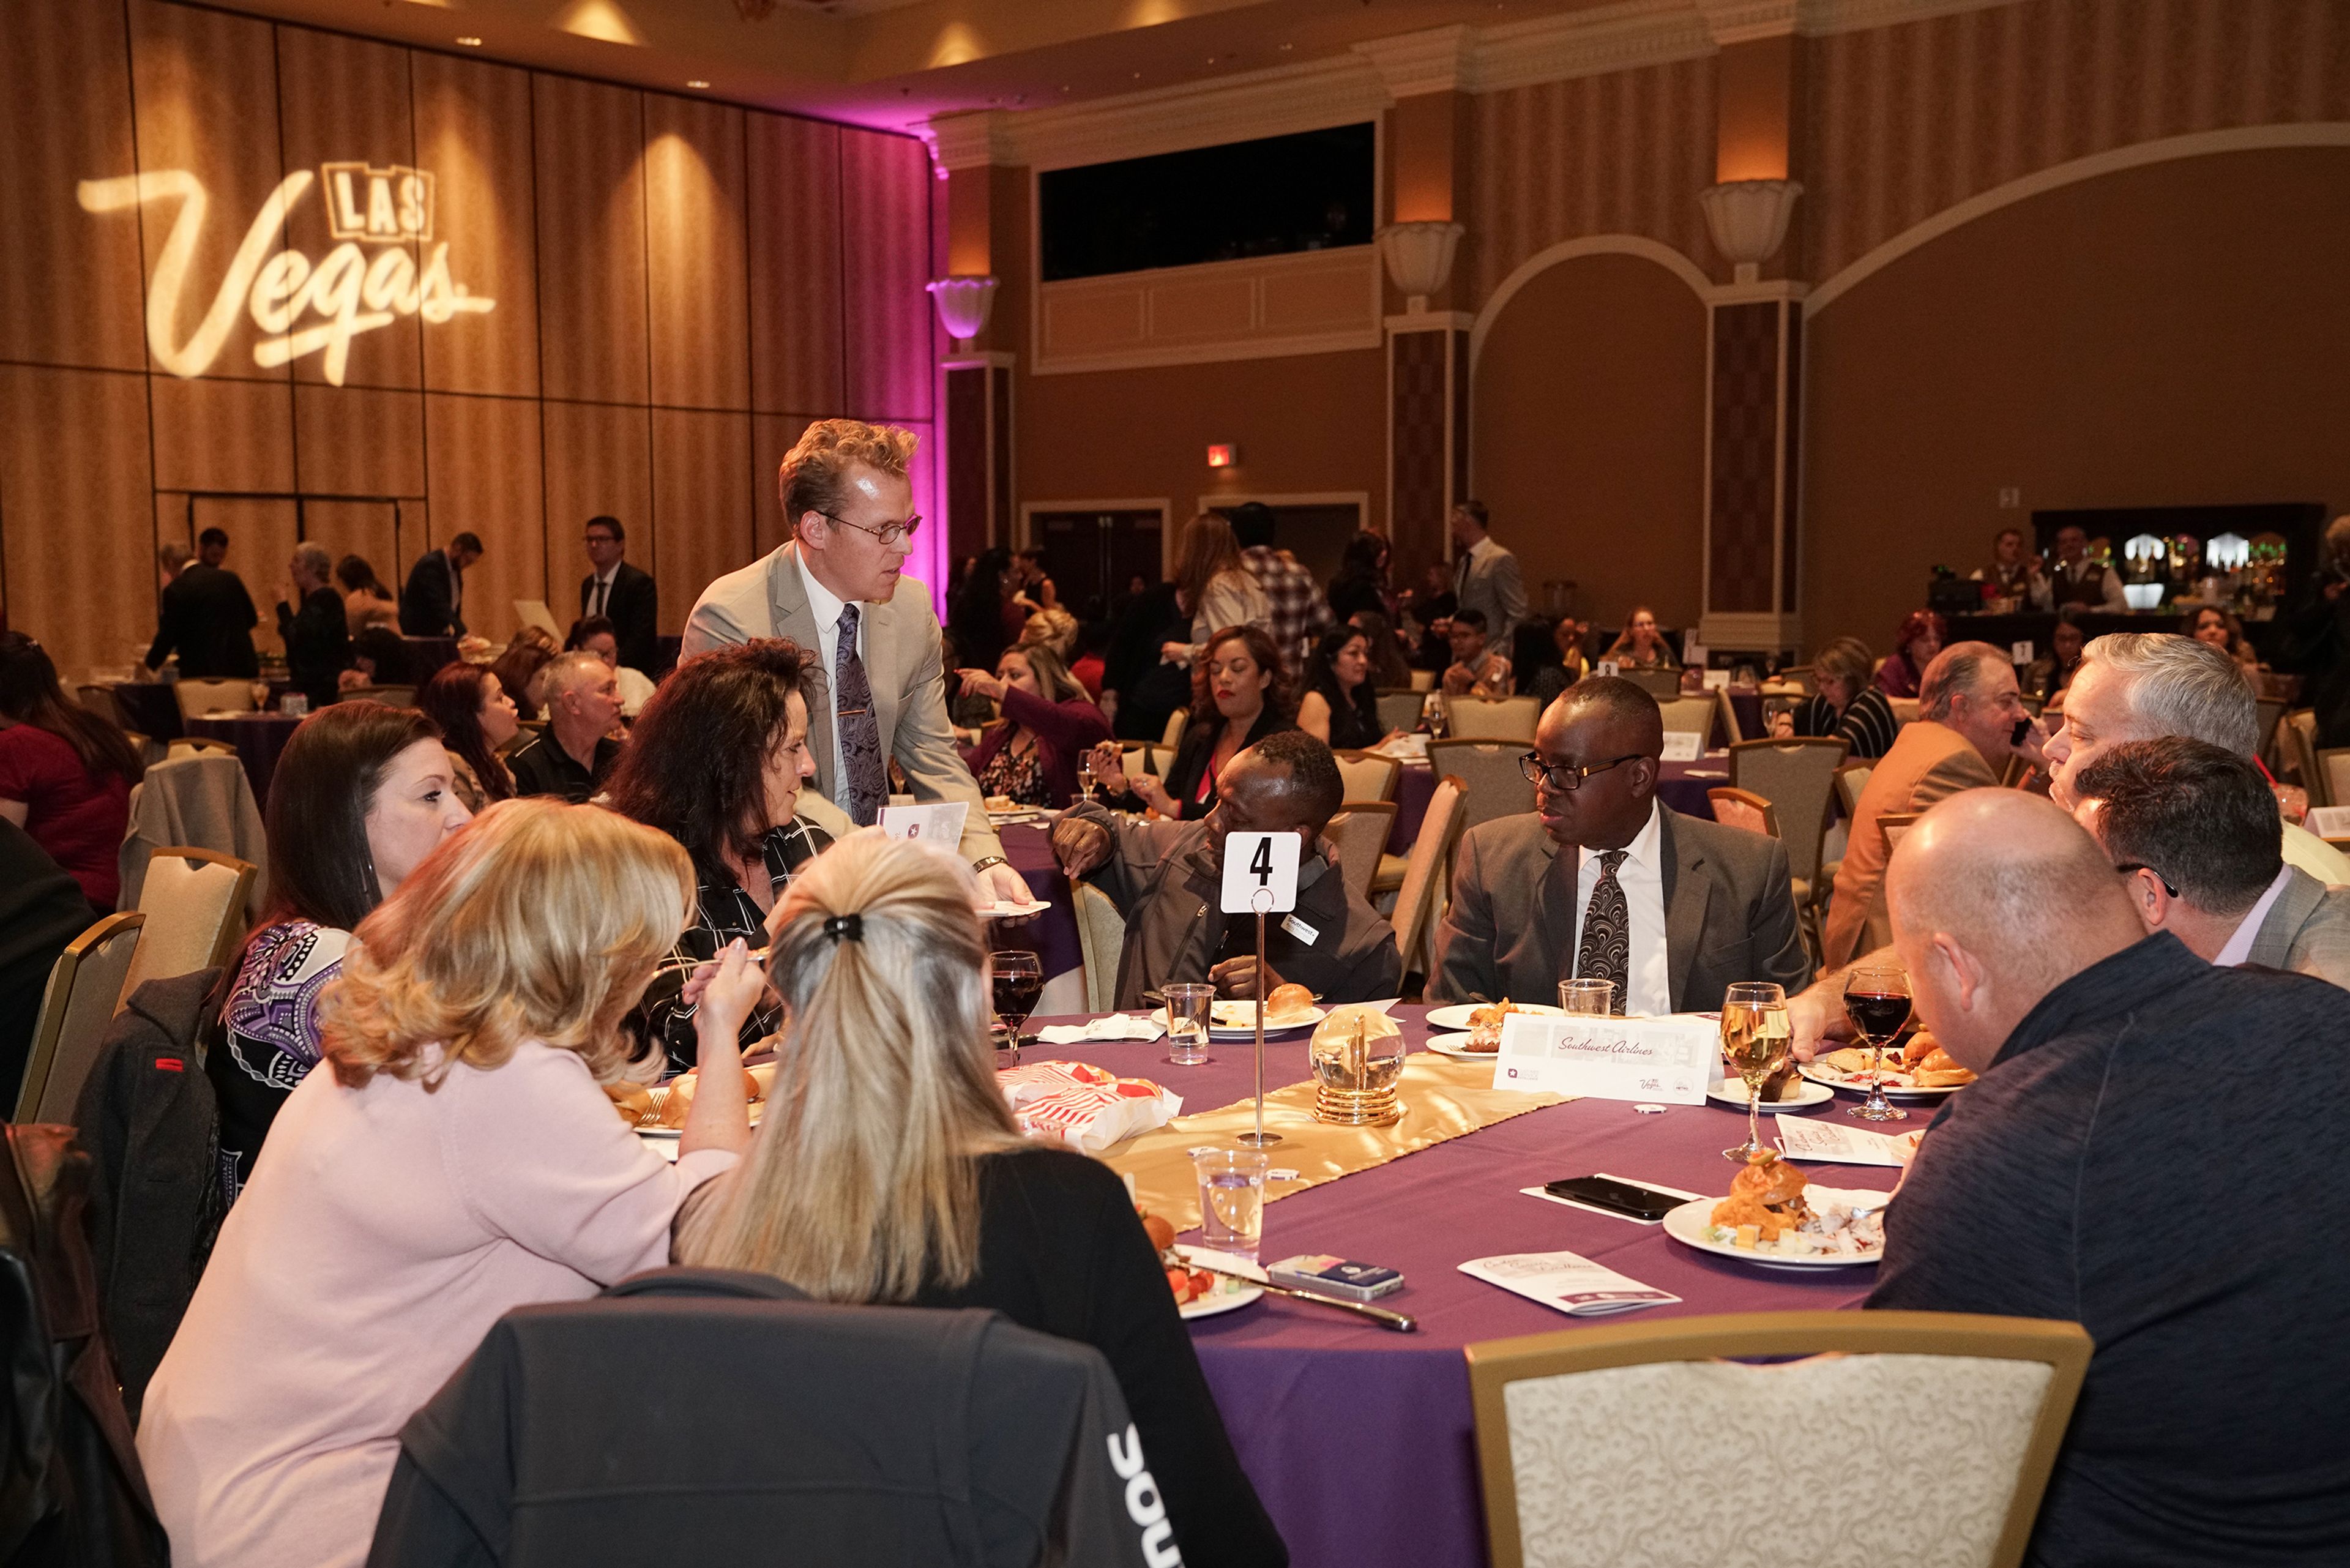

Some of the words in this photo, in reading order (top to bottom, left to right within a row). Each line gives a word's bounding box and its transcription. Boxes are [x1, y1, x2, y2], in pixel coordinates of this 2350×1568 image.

[334, 171, 425, 233] LAS
[77, 169, 496, 387] Vegas
[1250, 837, 1273, 886] 4
[1288, 917, 1313, 935] Southwest
[1558, 1036, 1611, 1052] Southwest
[1611, 1040, 1653, 1055] Airlines
